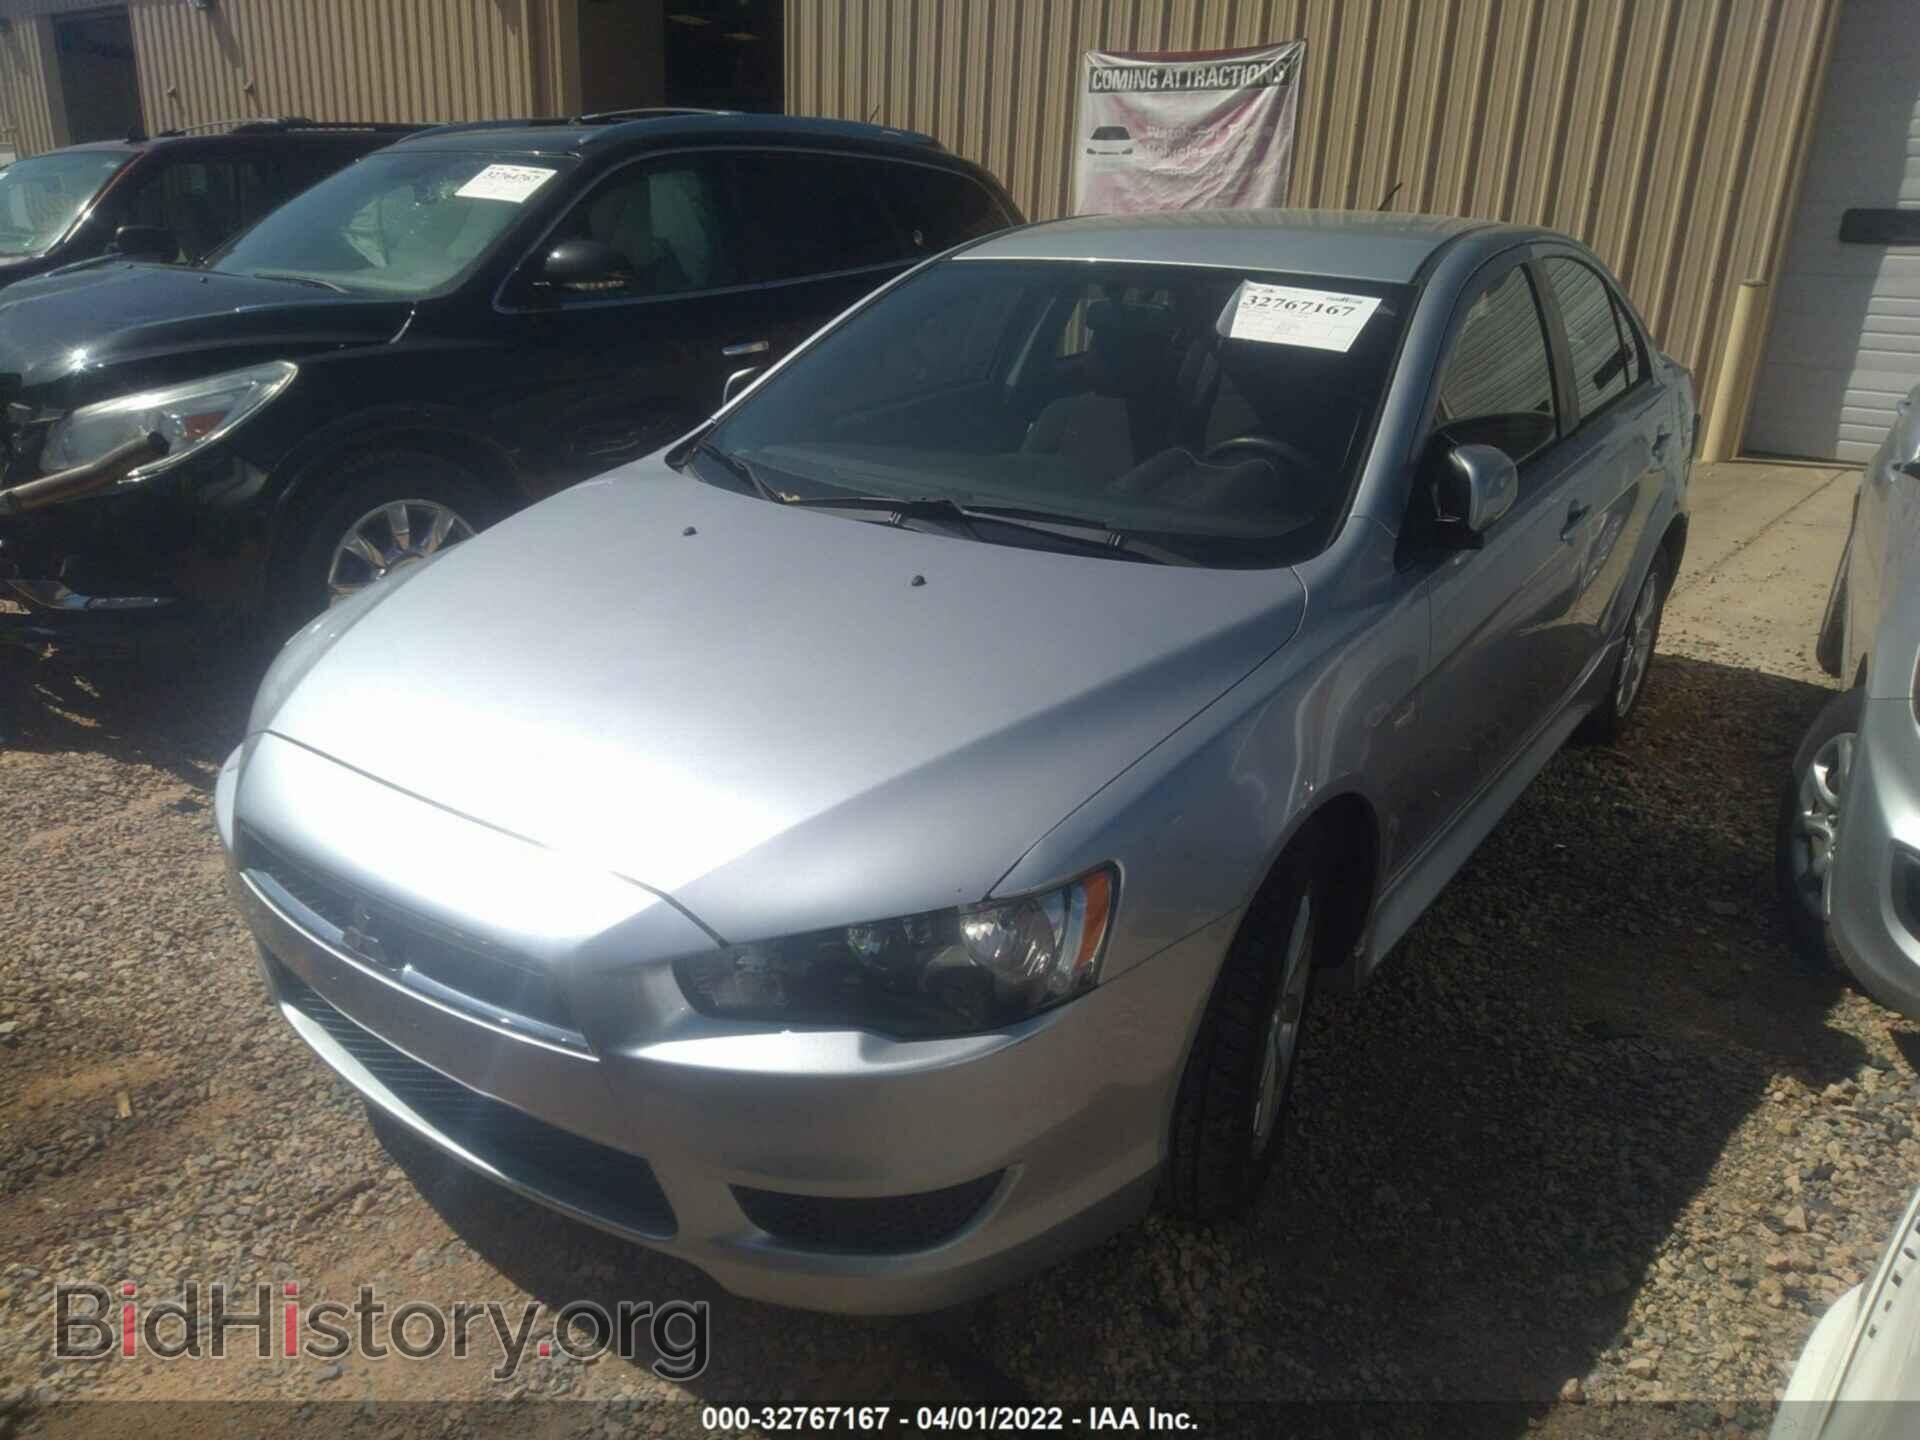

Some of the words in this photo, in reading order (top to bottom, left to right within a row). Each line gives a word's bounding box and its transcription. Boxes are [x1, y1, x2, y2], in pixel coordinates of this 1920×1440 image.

[1092, 67, 1158, 90] COMING
[1161, 62, 1285, 89] ATTRACTIONS
[1242, 295, 1356, 317] 32767167
